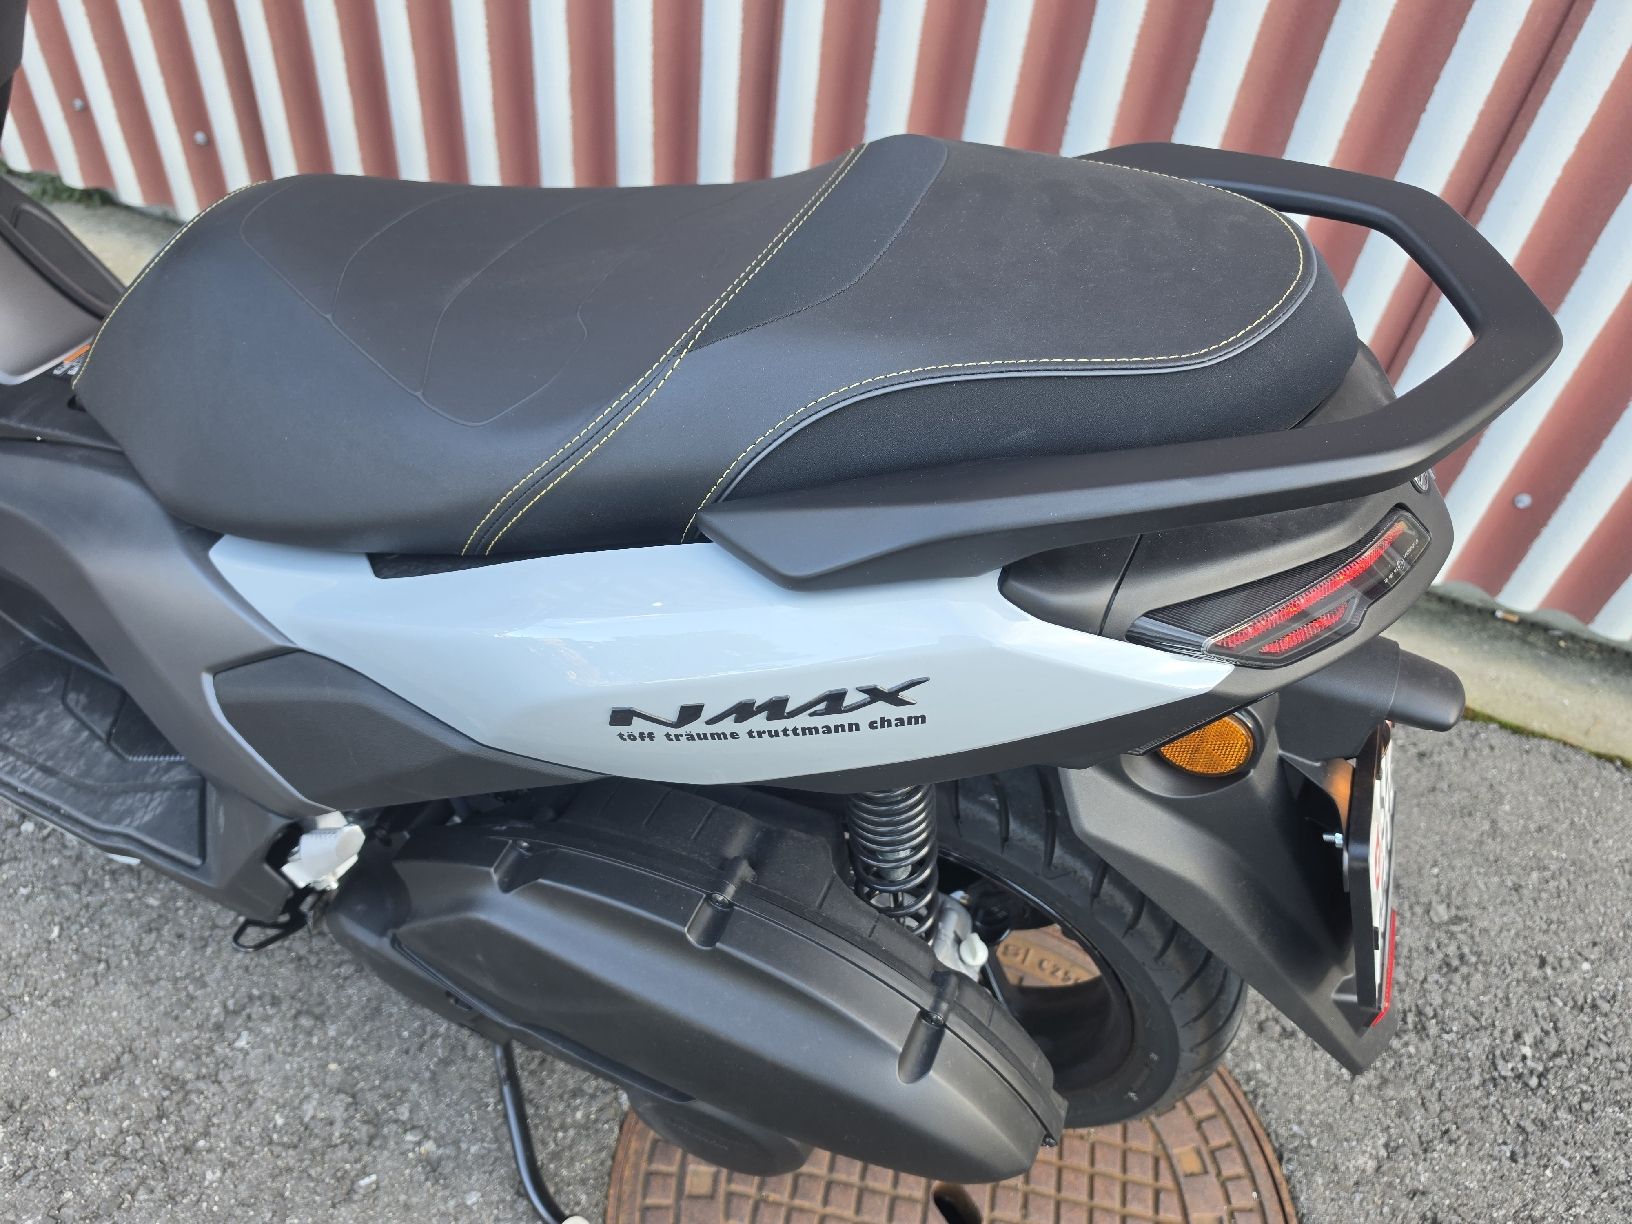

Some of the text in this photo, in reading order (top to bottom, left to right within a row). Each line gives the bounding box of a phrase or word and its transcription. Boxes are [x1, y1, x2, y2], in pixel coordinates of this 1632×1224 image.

[608, 676, 931, 729] NMAX
[616, 713, 927, 743] töff träume truttmann cham
